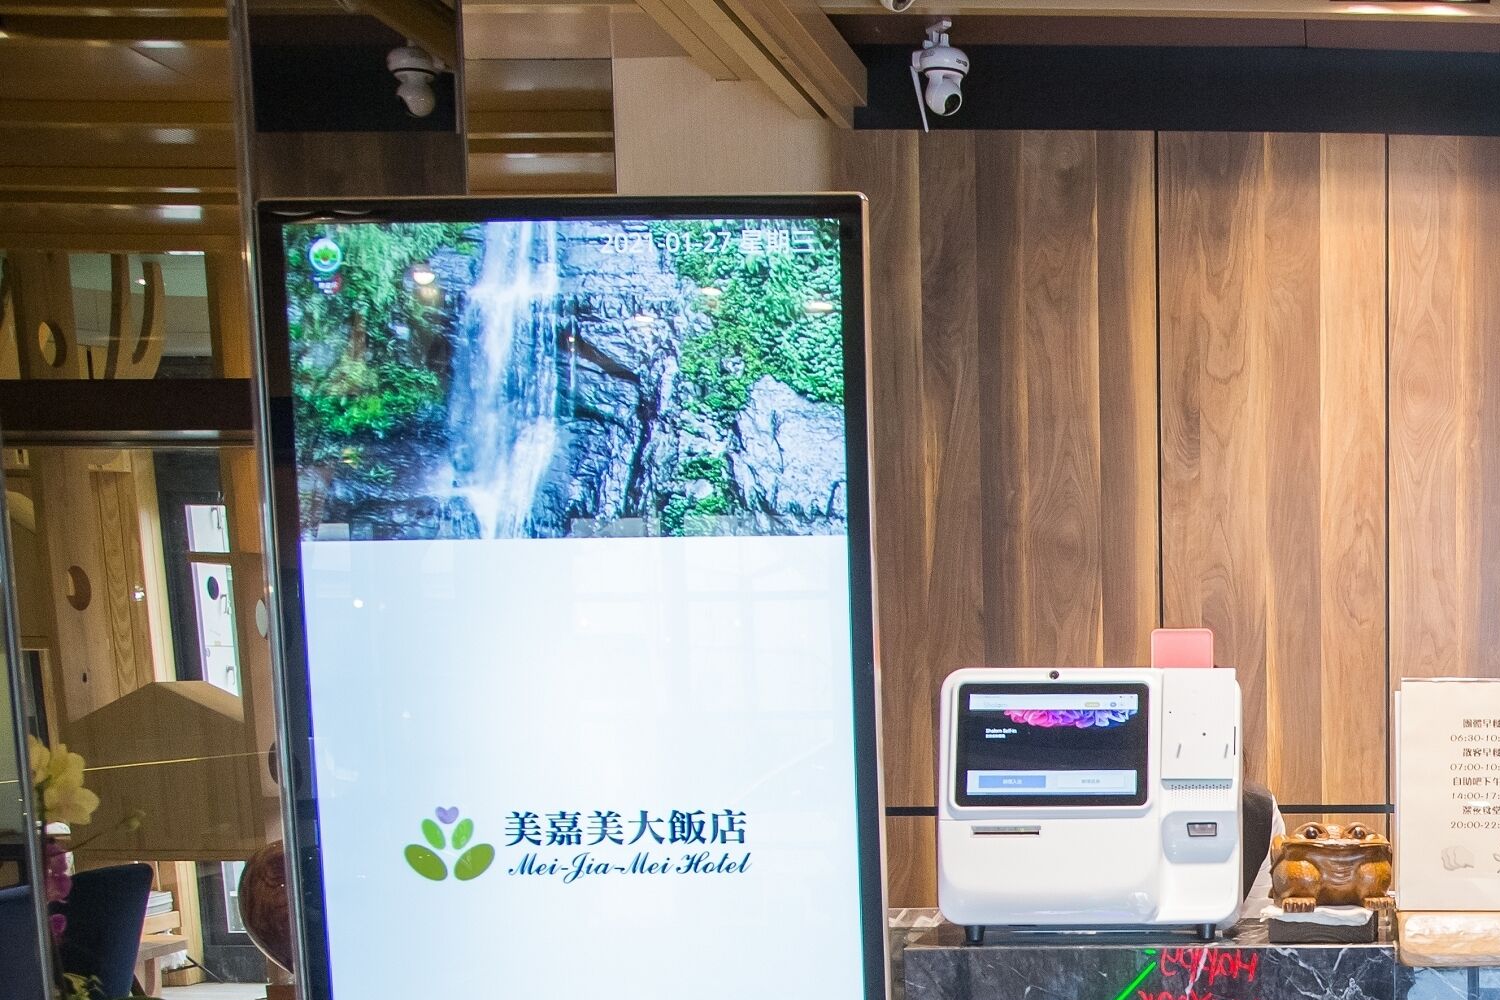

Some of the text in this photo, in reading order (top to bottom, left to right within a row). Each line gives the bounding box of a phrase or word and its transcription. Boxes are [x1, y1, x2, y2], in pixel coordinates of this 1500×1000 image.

[505, 809, 747, 847] 美嘉美大飯店
[508, 850, 753, 885] Mei-Jia-Mei Hotel
